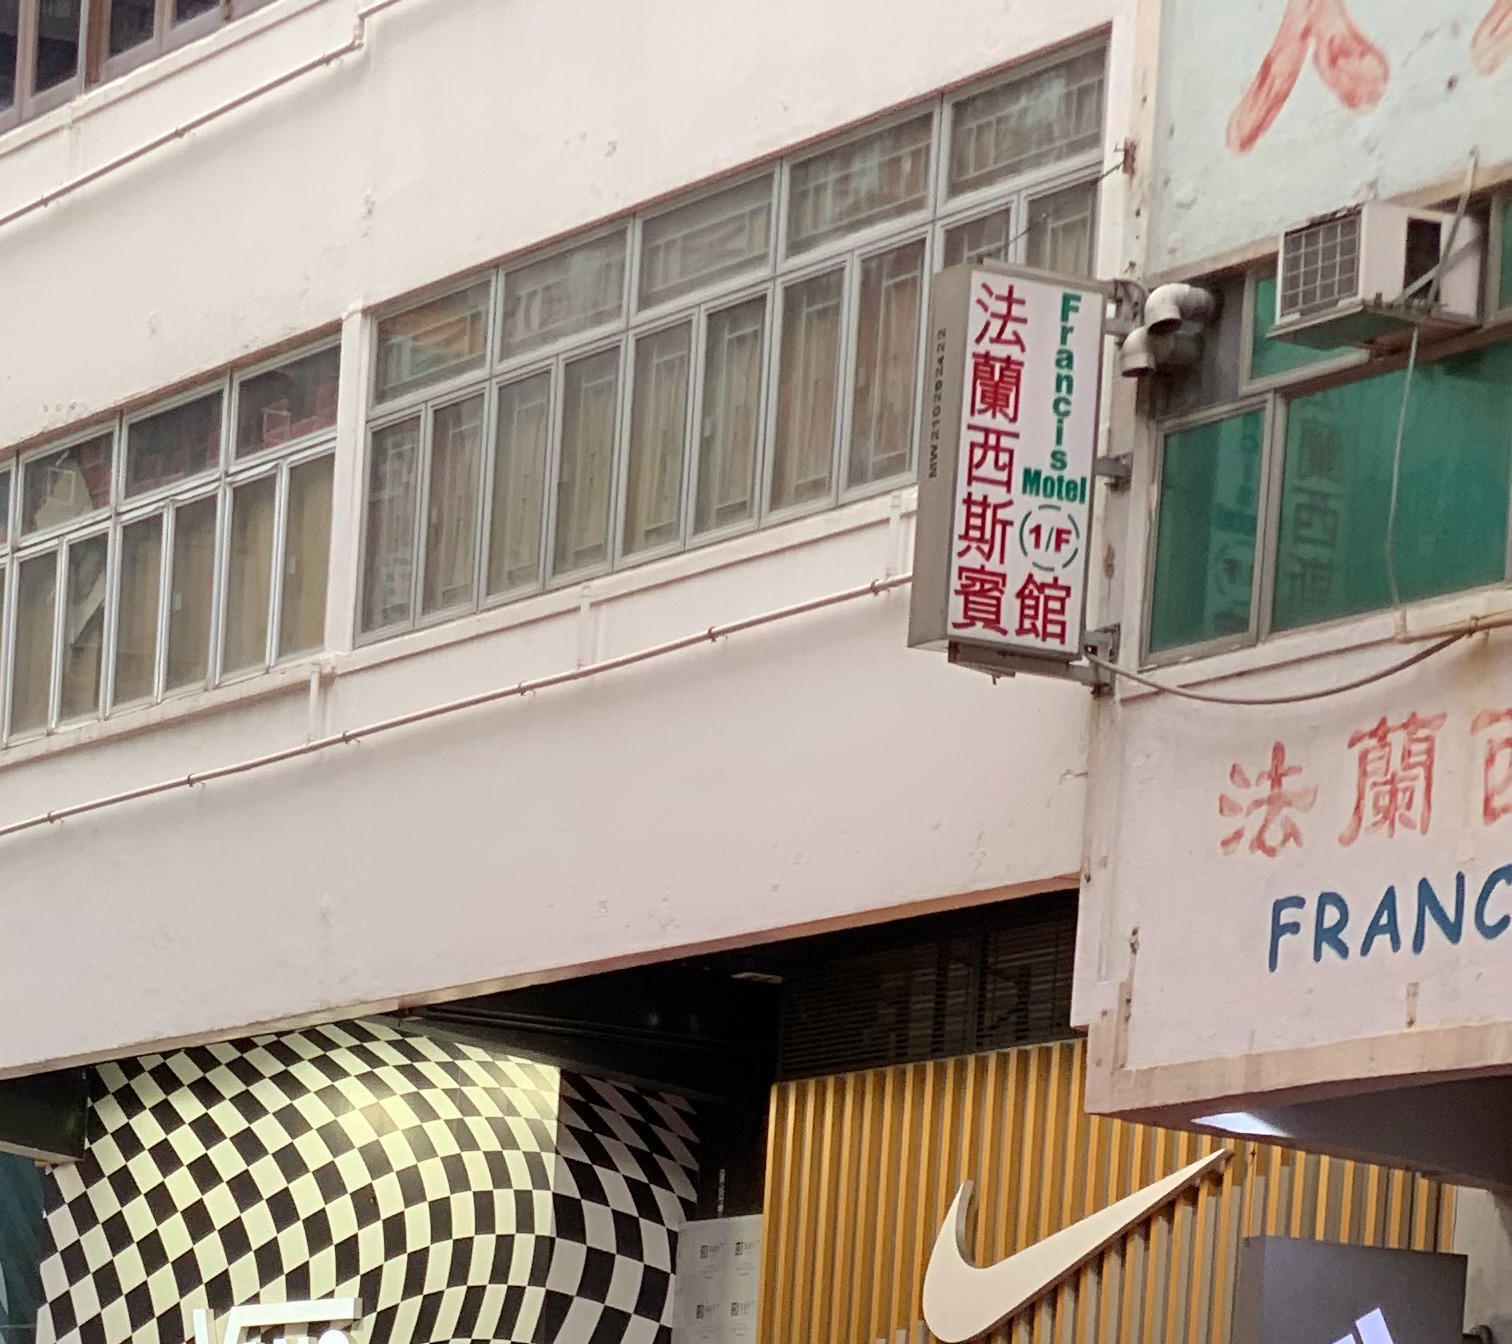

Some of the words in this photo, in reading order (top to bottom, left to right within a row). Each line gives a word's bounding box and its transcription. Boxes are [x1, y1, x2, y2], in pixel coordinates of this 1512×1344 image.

[1052, 292, 1081, 471] Francis
[1021, 467, 1087, 504] Motel
[1029, 523, 1072, 554] 1/F
[1267, 863, 1512, 973] FRANC
